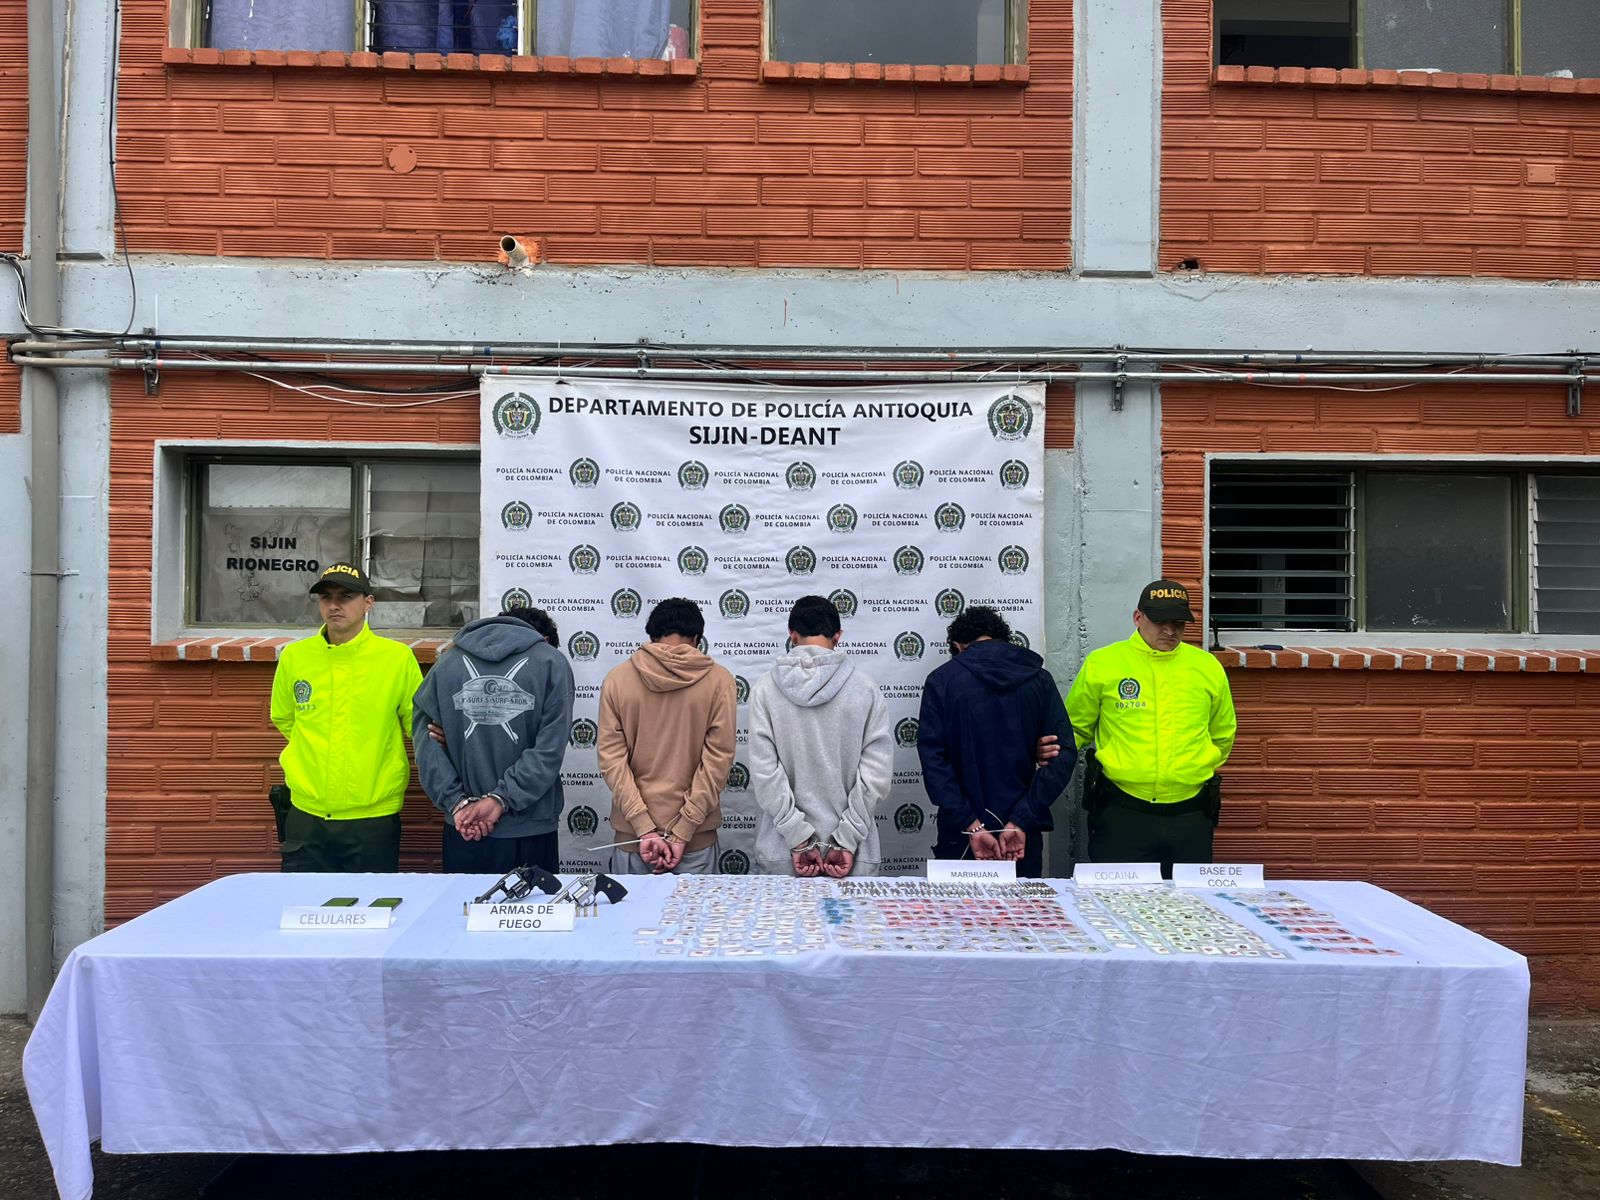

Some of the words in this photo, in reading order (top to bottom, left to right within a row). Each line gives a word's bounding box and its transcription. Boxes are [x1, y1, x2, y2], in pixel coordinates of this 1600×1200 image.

[550, 397, 723, 417] DEPARTAMENTO
[732, 403, 757, 417] DE
[765, 399, 846, 418] POLICÍA
[853, 402, 973, 422] ANTIOQUIA
[689, 426, 841, 445] SIJIN-DEANT
[250, 535, 297, 550] SIJIN
[226, 558, 320, 573] RIONEGRO
[1094, 871, 1139, 880] COCAINA
[1200, 867, 1226, 876] BASE
[1228, 867, 1242, 876] DE
[1208, 879, 1237, 888] COCA
[489, 904, 532, 915] ARMAS
[537, 904, 554, 915] DE
[299, 913, 367, 925] CELULARES
[498, 919, 542, 929] FUEGO
